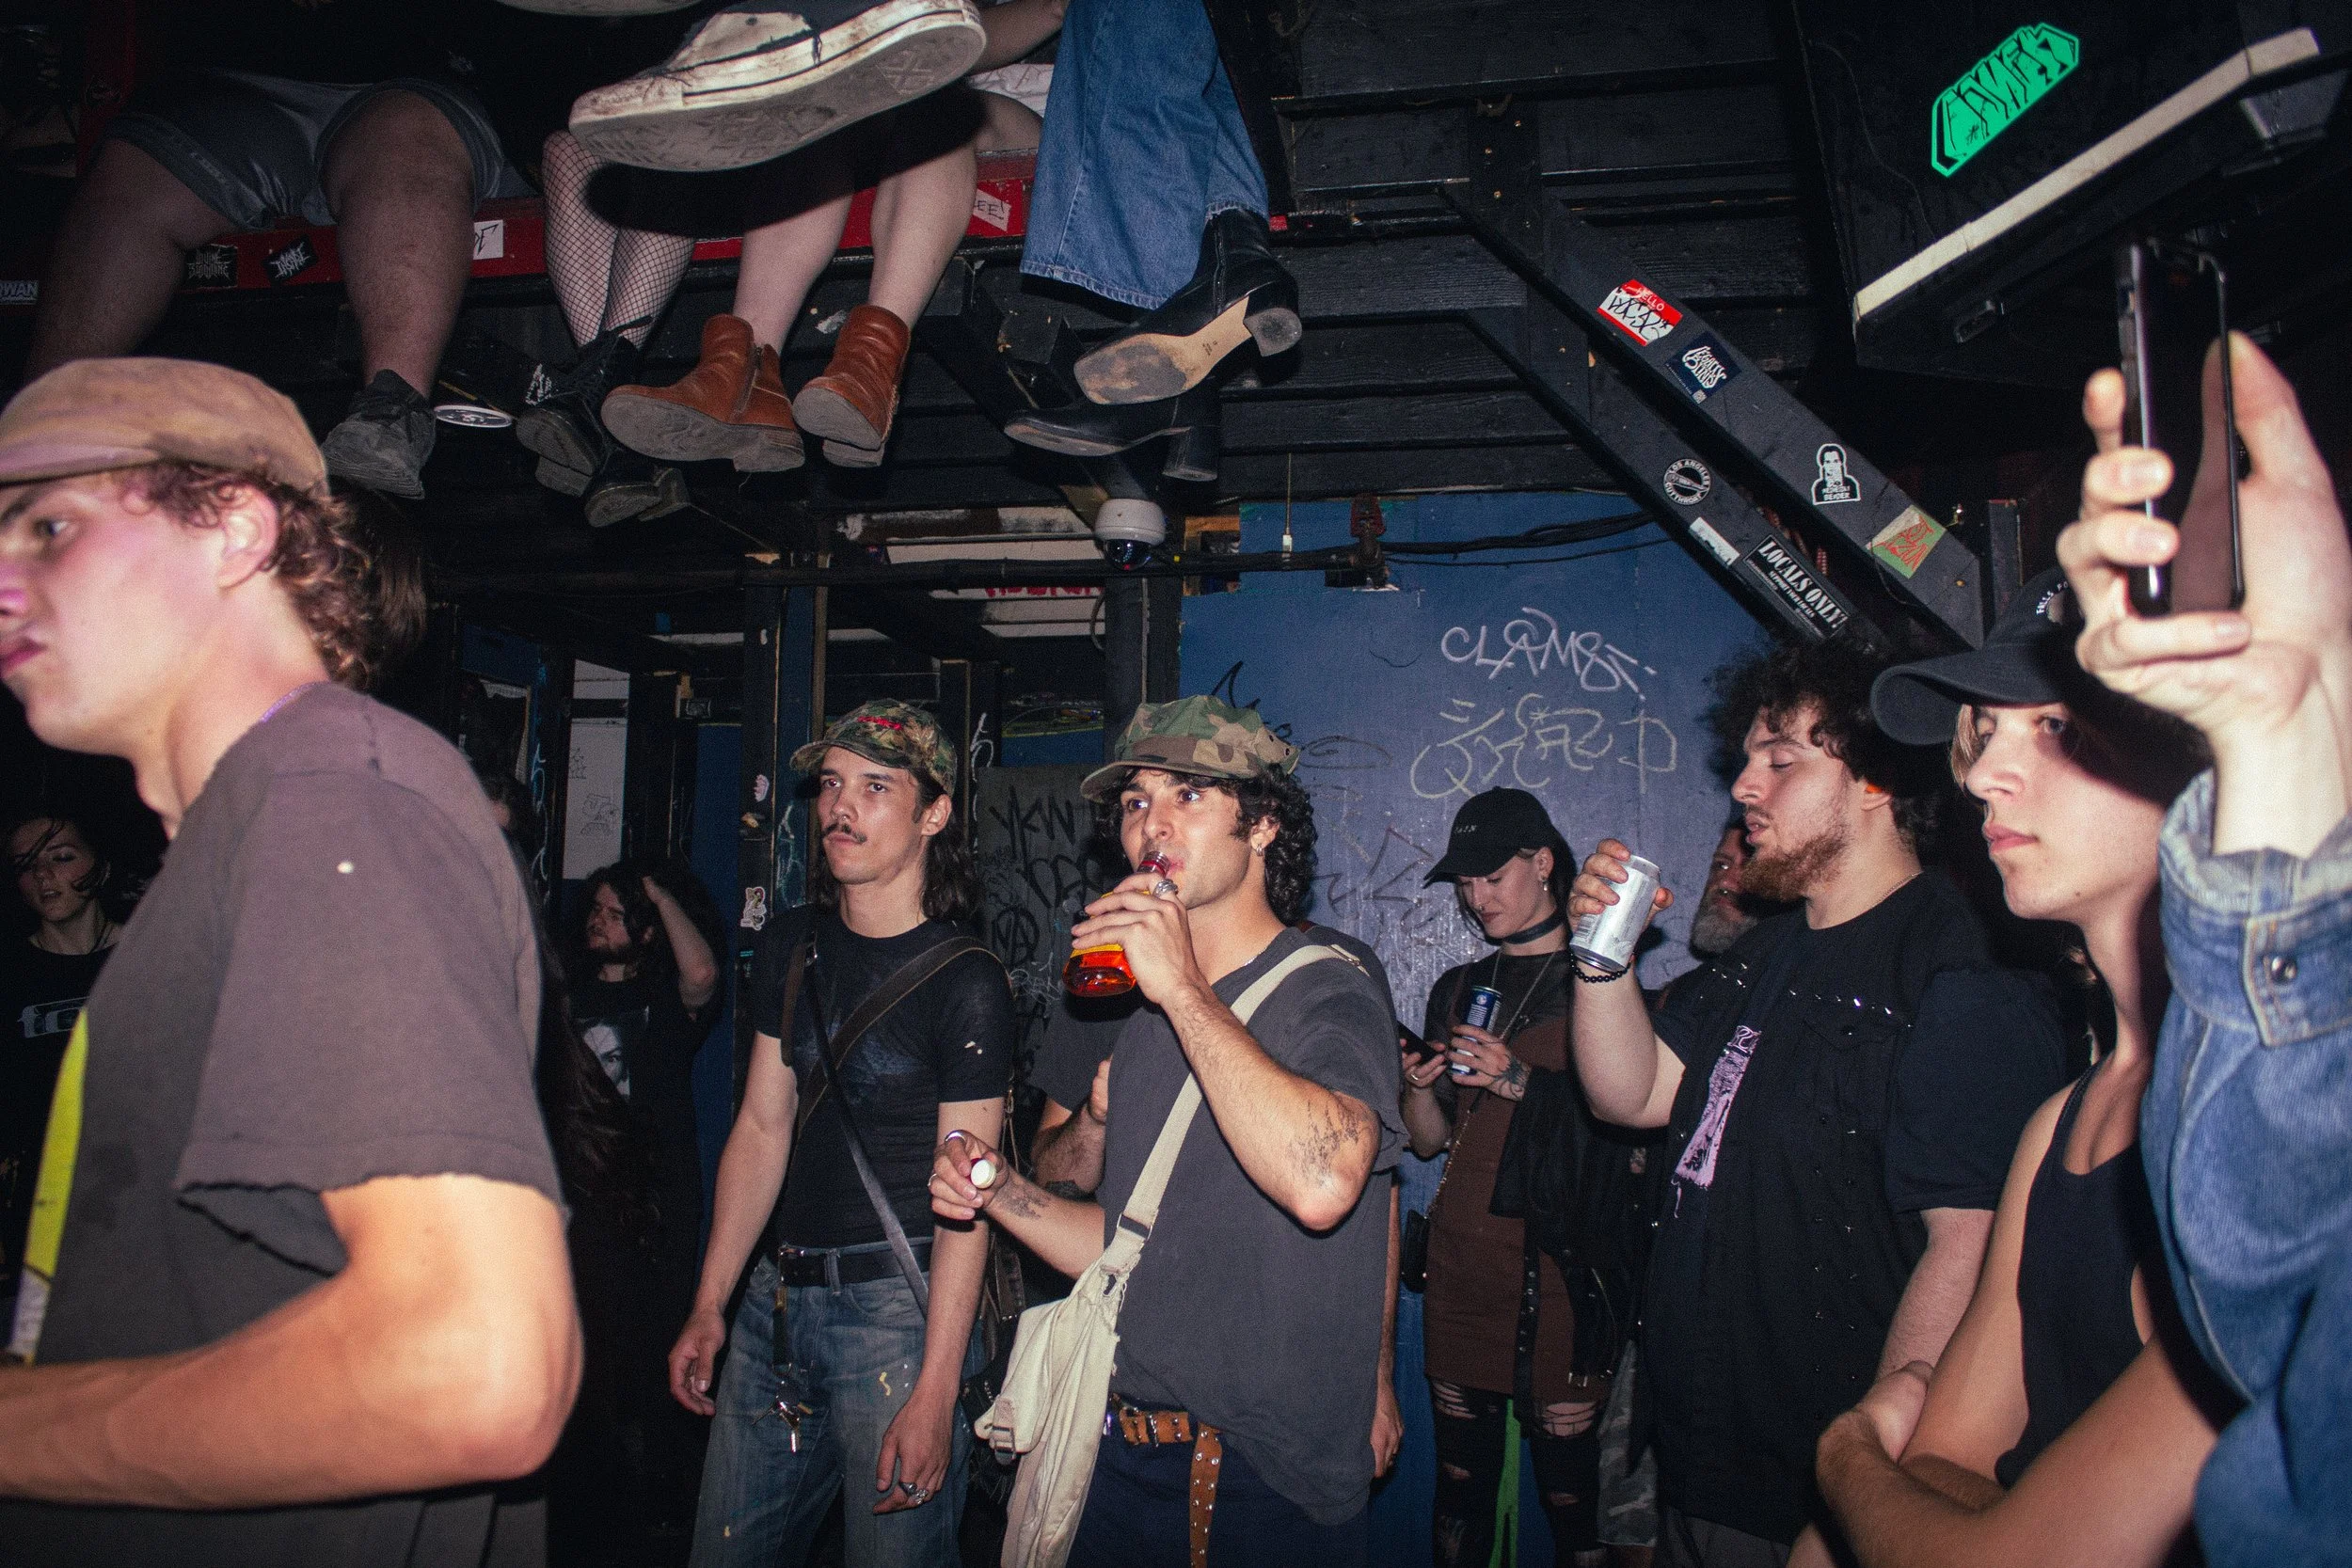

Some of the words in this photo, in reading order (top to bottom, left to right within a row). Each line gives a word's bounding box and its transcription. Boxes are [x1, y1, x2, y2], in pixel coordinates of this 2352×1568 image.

[975, 199, 1006, 220] EE!
[1684, 460, 1710, 486] ANGELES
[1758, 541, 1813, 592] LOCALS
[1805, 587, 1848, 627] ONLY!
